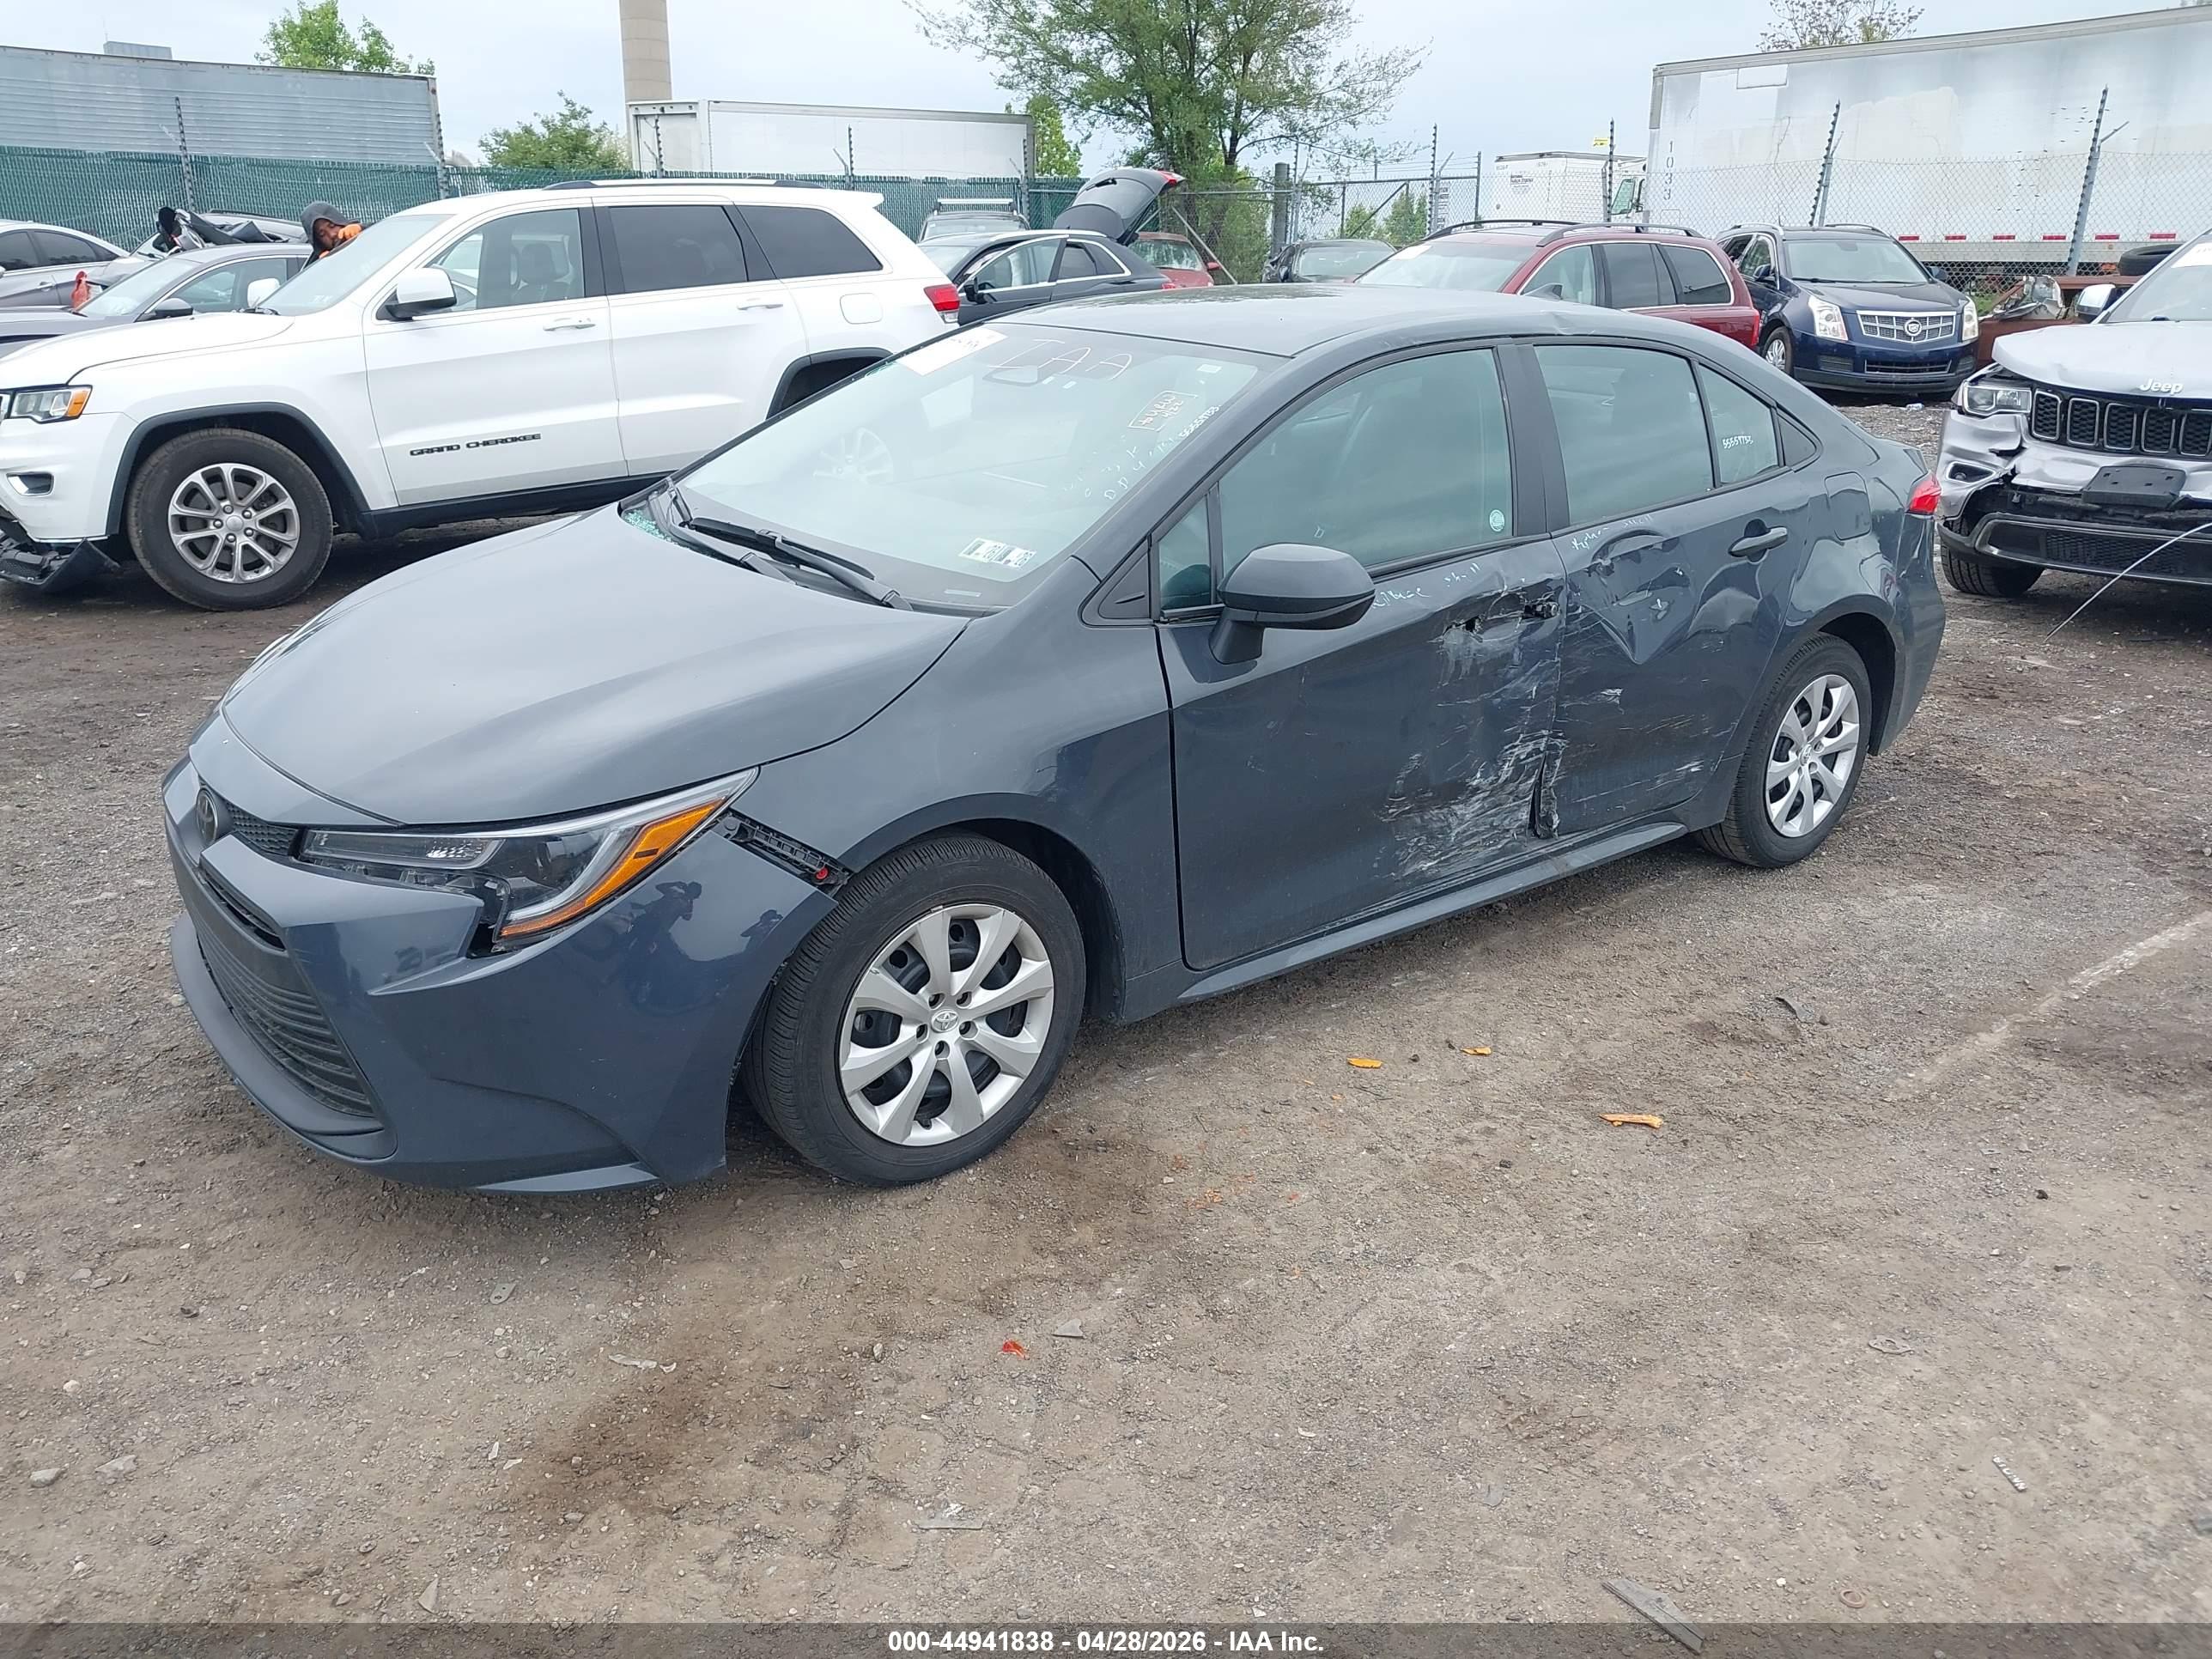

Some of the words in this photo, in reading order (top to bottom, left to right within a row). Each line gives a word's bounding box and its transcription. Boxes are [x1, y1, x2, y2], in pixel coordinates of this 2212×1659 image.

[2138, 378, 2184, 397] Jeep
[410, 444, 461, 457] GRAND
[465, 433, 542, 449] CHEROKEE
